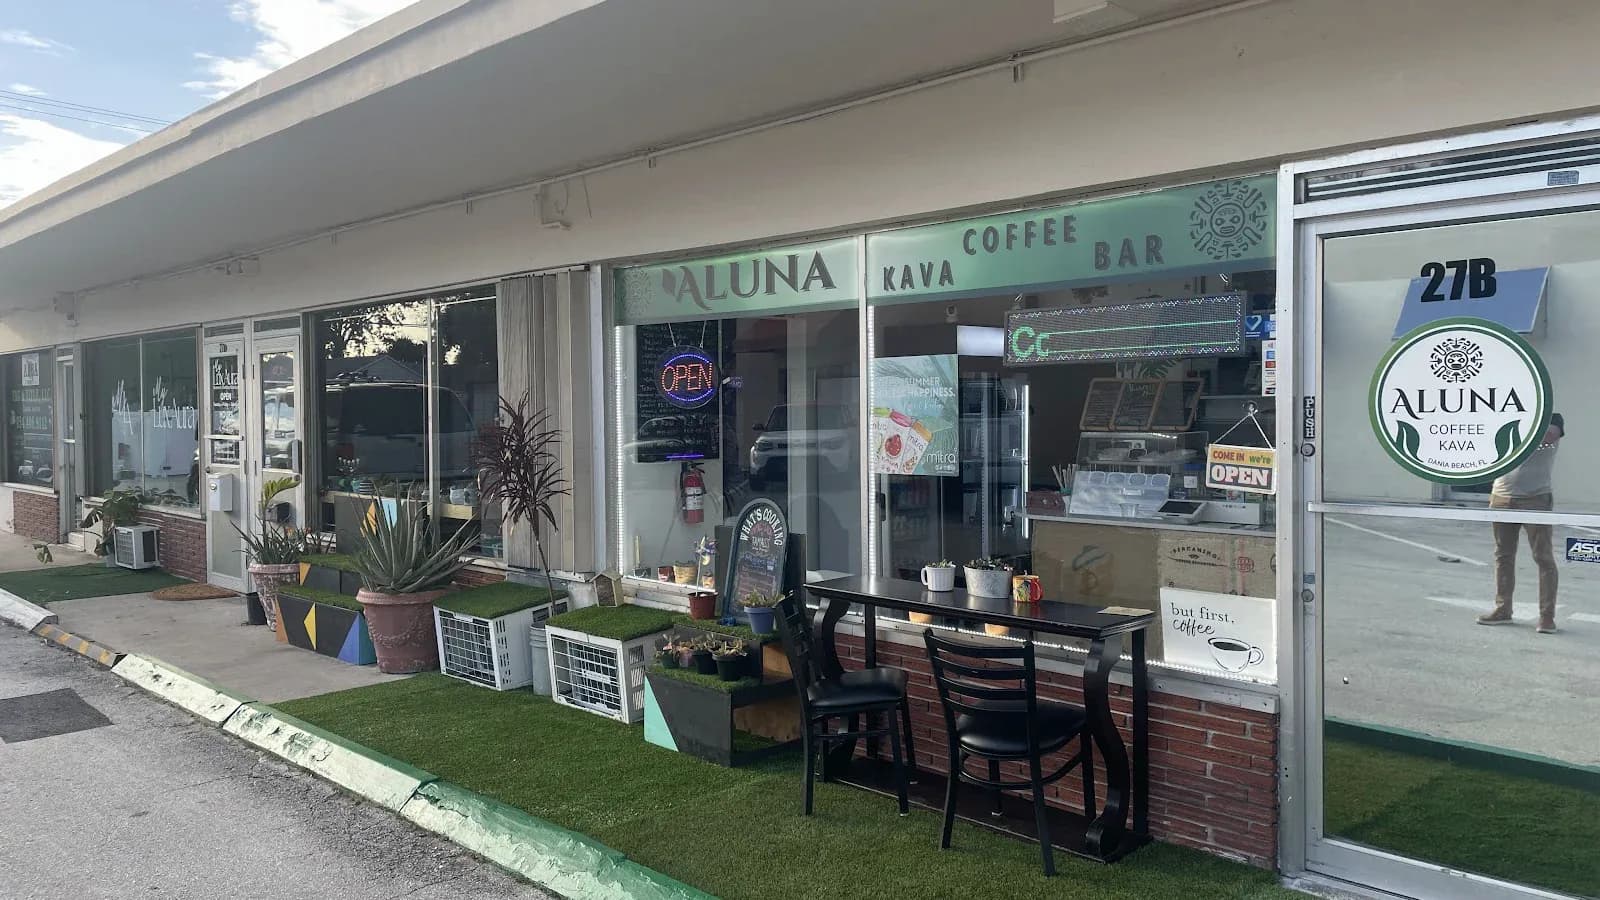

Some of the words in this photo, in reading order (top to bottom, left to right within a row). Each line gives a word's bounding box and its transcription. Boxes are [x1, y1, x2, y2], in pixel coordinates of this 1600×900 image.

[963, 214, 1077, 256] COFFEE
[883, 259, 955, 292] KAVA
[1094, 233, 1165, 271] BAR
[675, 250, 837, 311] ALUNA
[1420, 257, 1497, 303] 27B
[661, 362, 713, 392] OPEN
[1305, 398, 1315, 438] PUSH
[1389, 386, 1528, 421] ALUNA
[1429, 424, 1485, 435] COFFEE
[1213, 450, 1235, 461] COME
[1236, 450, 1245, 461] IN
[1249, 453, 1272, 465] we're
[1439, 440, 1476, 451] KAVA
[1211, 464, 1269, 486] OPEN
[1427, 457, 1450, 468] DANIA
[1451, 461, 1478, 469] BEACH,
[740, 508, 762, 541] WHAT'S
[763, 508, 784, 546] COOKING
[1170, 602, 1194, 618] but
[1173, 618, 1215, 637] coffee
